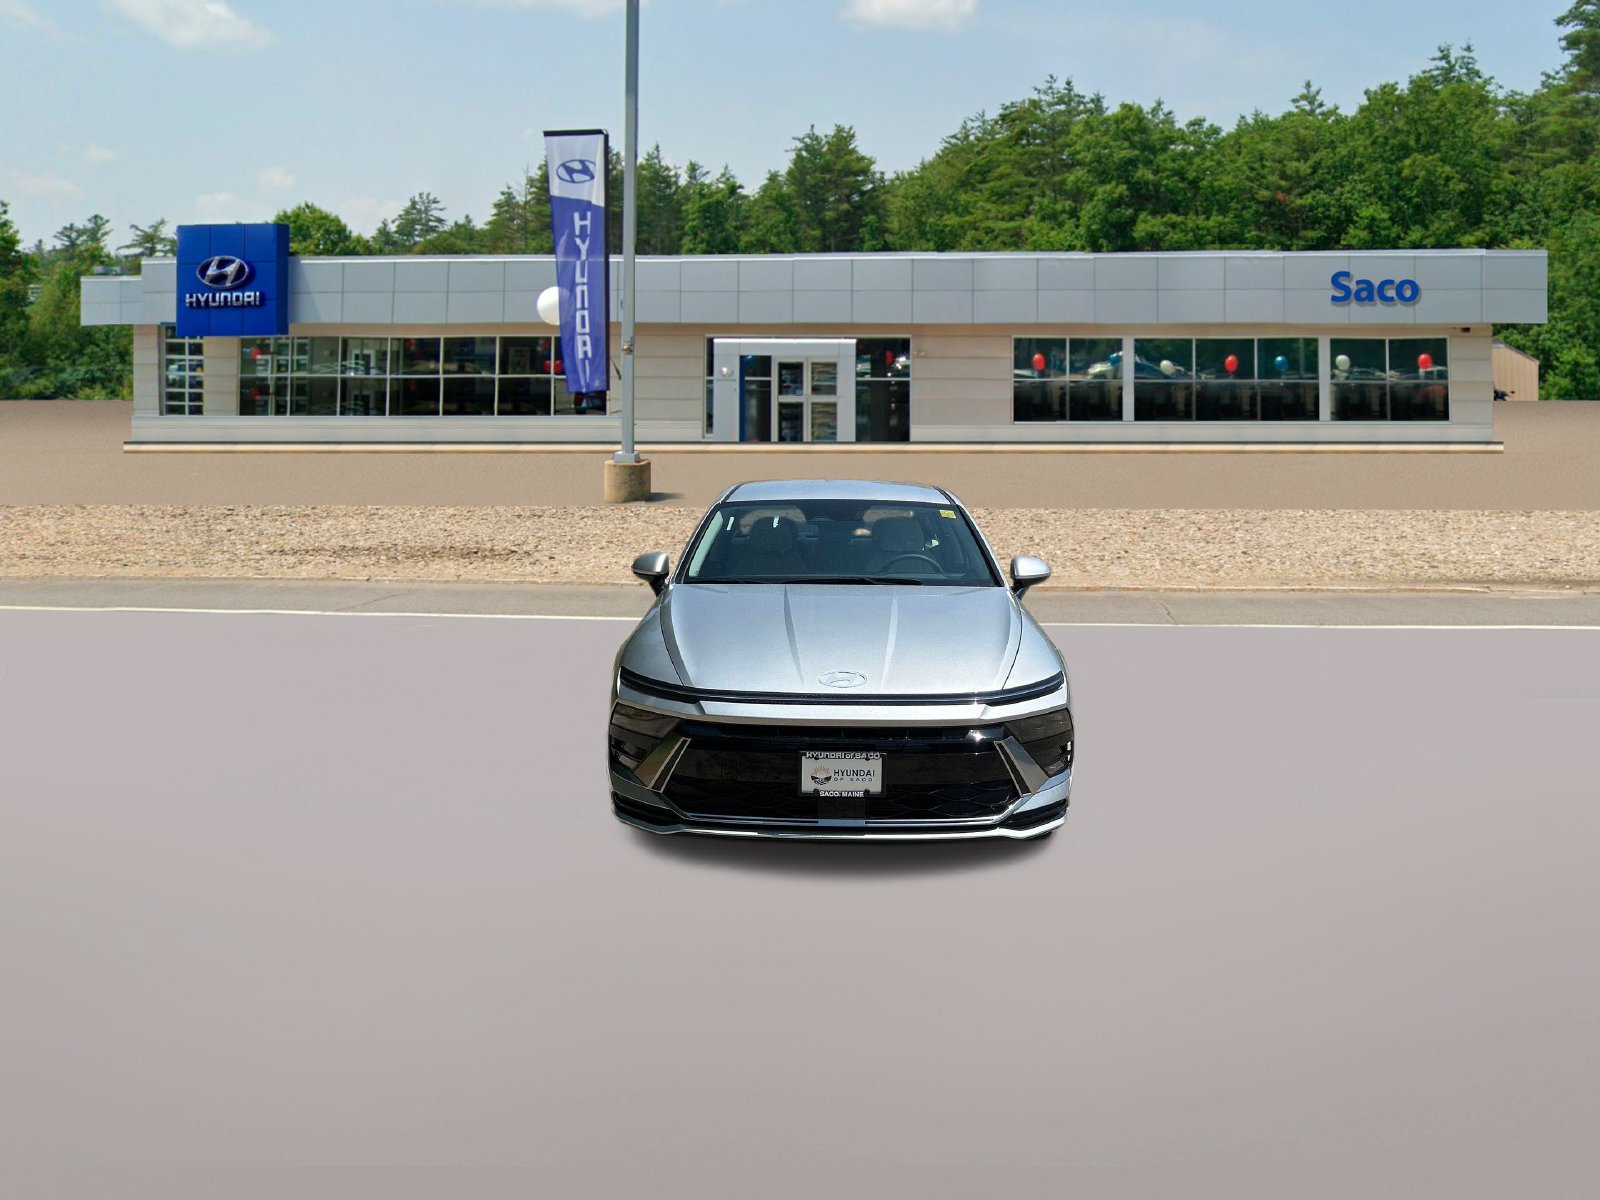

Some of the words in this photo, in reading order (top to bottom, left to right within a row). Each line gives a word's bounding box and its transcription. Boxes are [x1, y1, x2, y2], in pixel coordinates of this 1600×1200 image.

[572, 211, 592, 384] HYUNDAI
[1330, 270, 1420, 303] Saco
[185, 291, 260, 307] HYUNDAI
[833, 769, 875, 777] HYUNDAI
